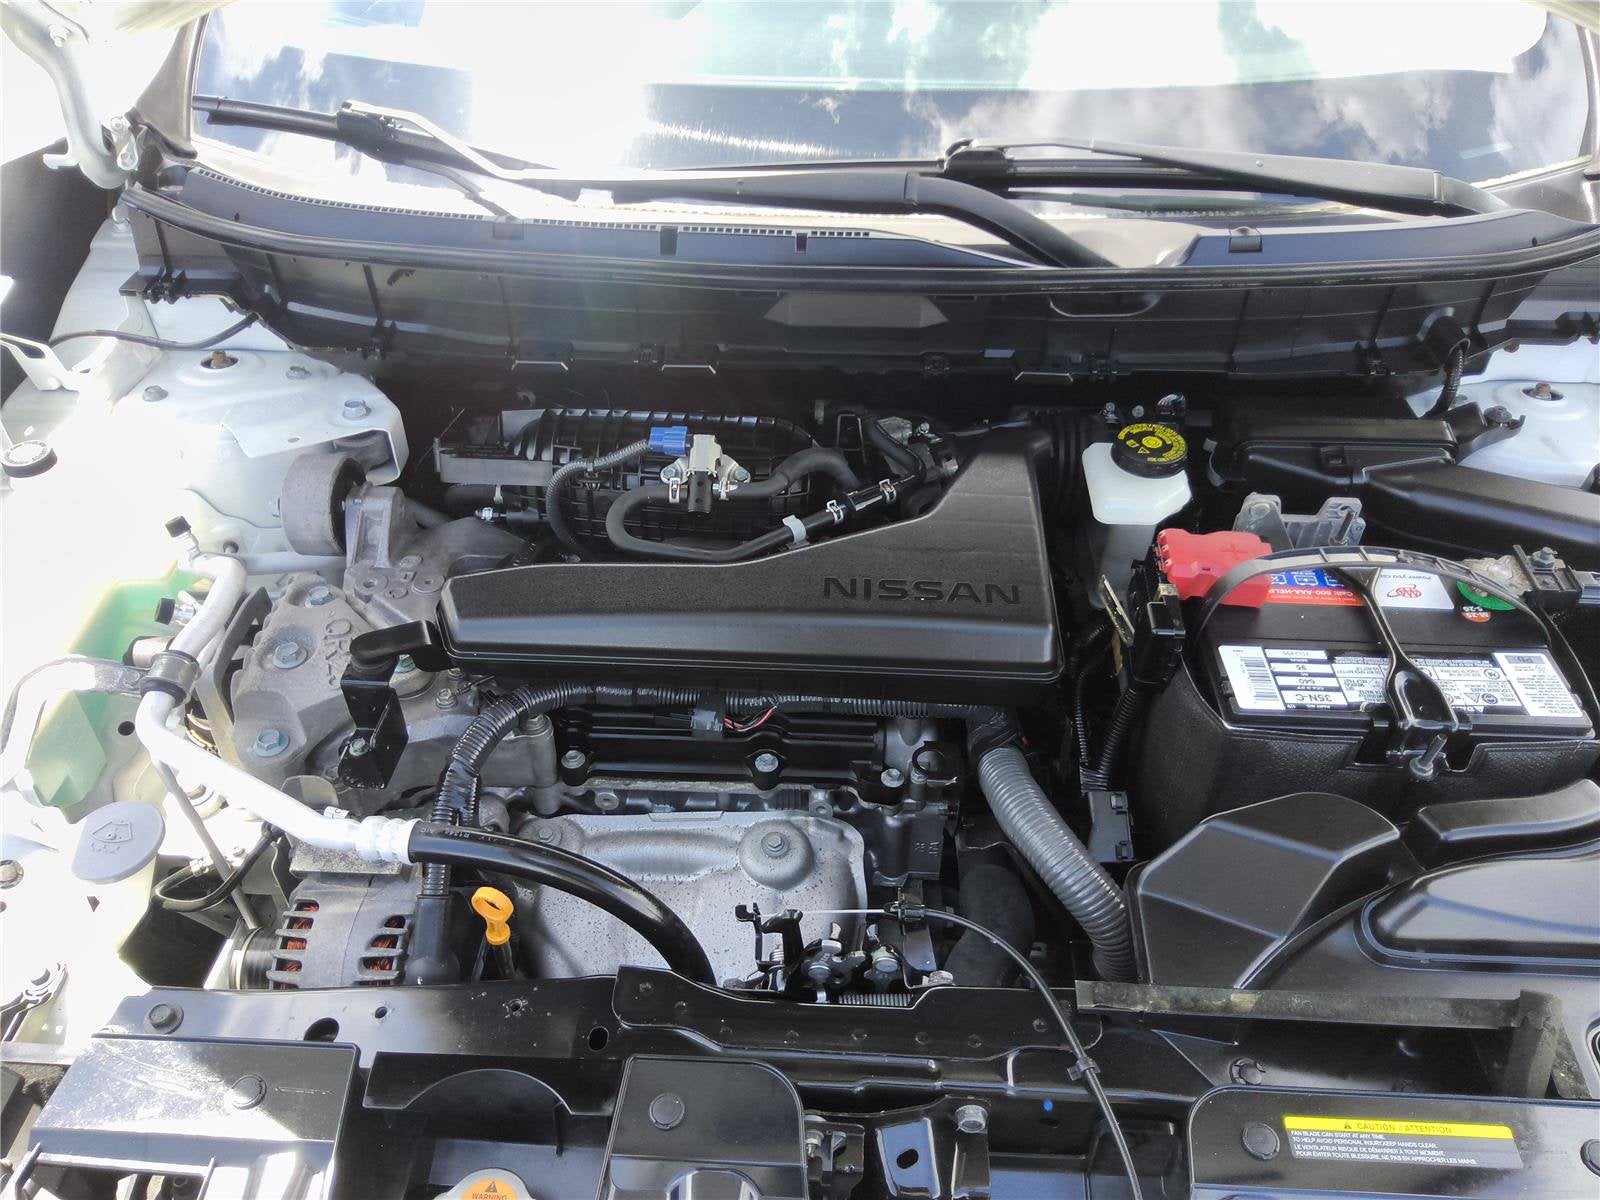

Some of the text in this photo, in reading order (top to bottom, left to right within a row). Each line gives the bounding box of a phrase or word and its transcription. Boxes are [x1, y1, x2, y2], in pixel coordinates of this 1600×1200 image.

[823, 577, 1021, 604] NISSAN
[1295, 693, 1333, 703] 35N-C
[1357, 1122, 1396, 1132] CAUTION
[1405, 1124, 1453, 1135] ATTENTION
[472, 1192, 508, 1200] WARNING
